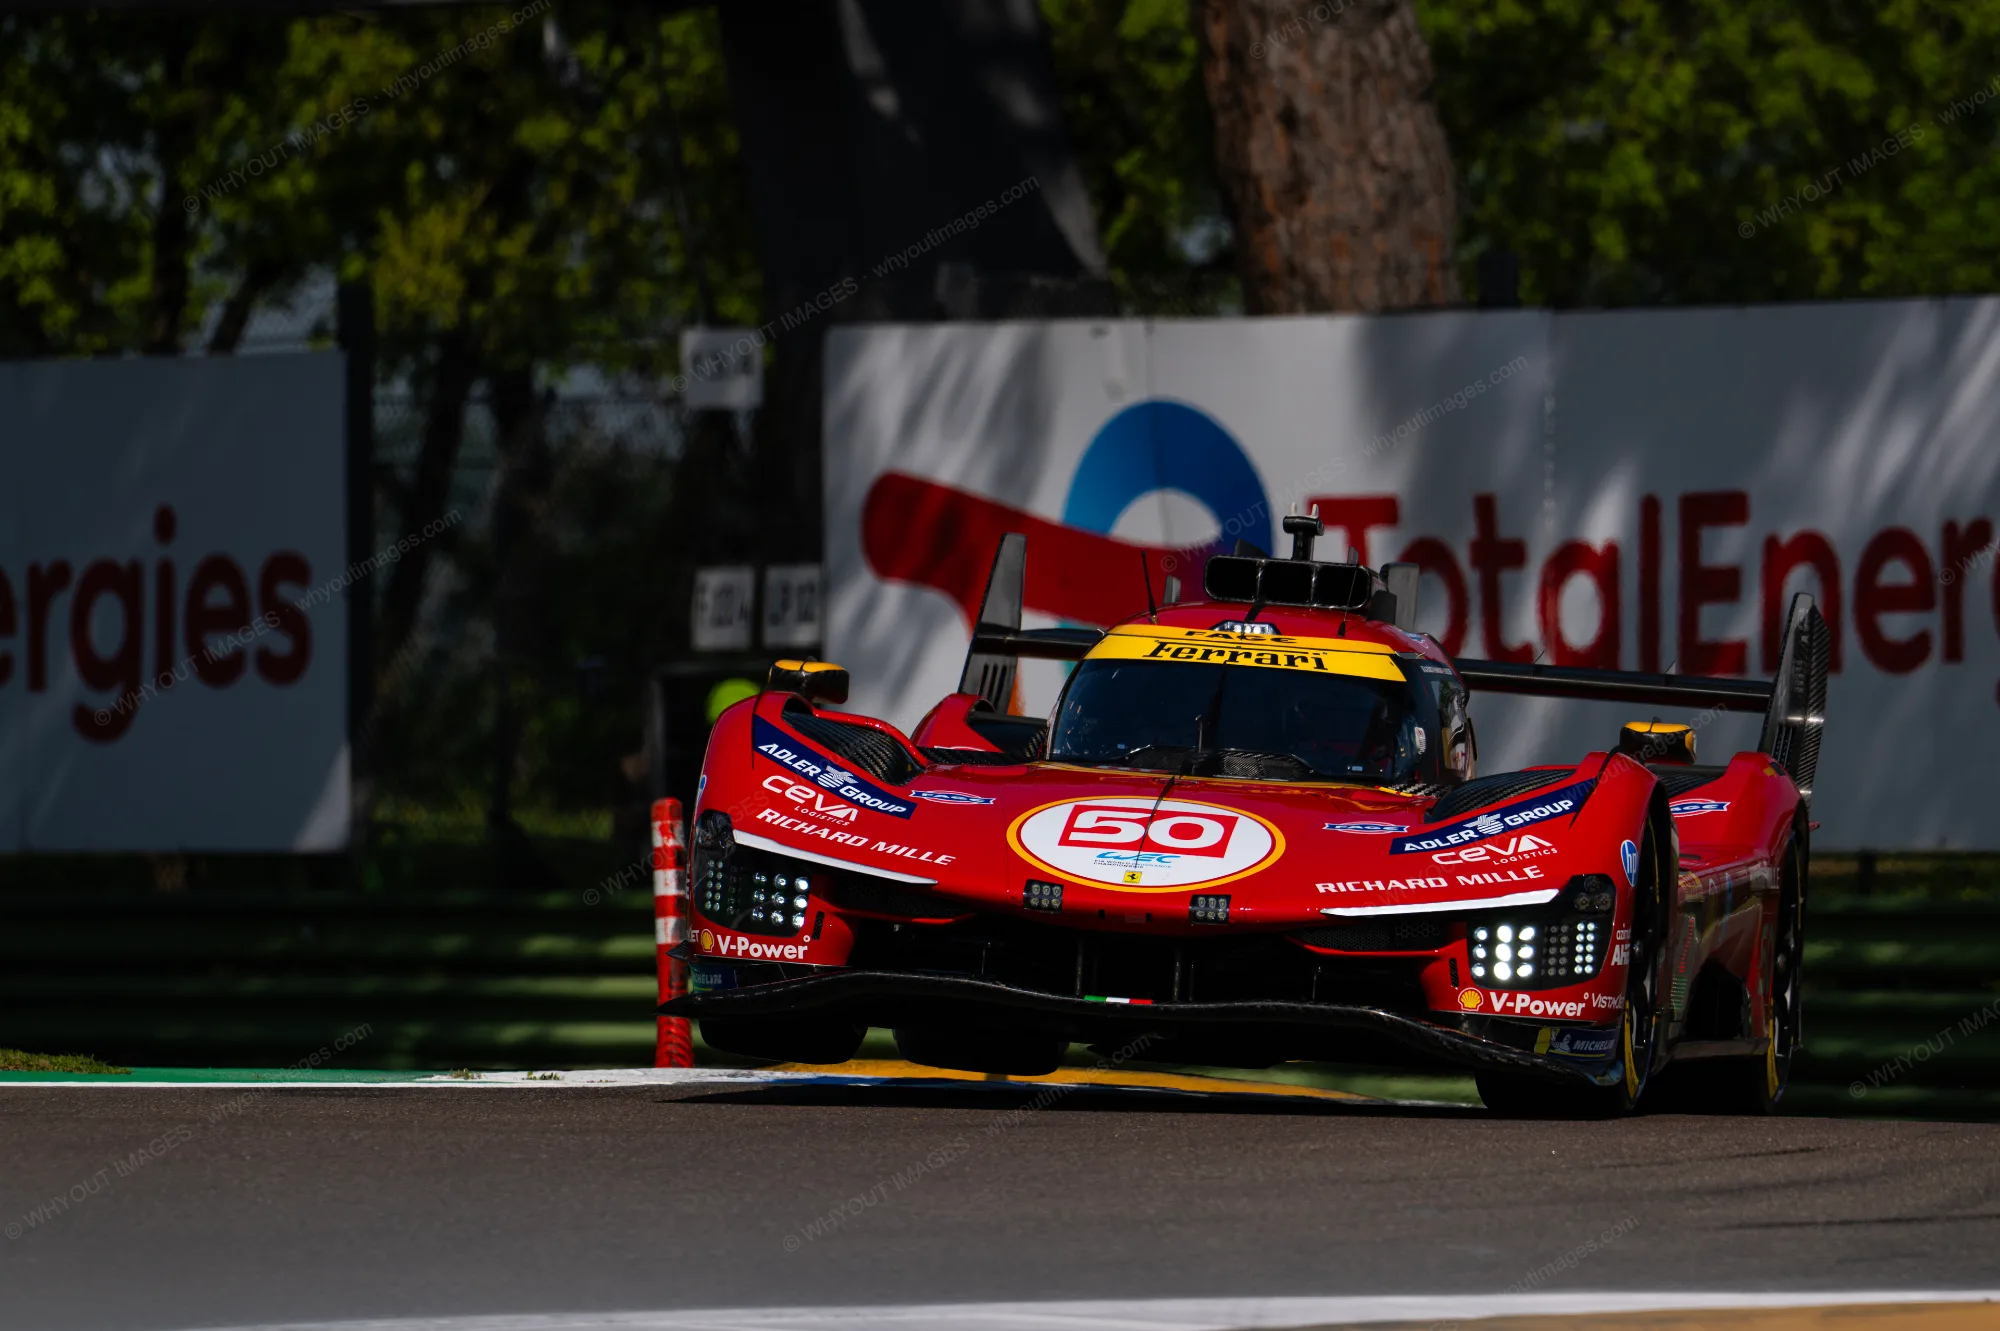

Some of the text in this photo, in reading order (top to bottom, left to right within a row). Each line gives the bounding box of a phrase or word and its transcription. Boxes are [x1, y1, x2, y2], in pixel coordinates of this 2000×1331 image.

[1308, 491, 2000, 680] TotalEner
[1142, 639, 1328, 670] Ferrari
[757, 742, 908, 814] ADLER GROUP
[793, 805, 850, 826] LOGISTICS
[1068, 809, 1225, 849] 50
[1403, 799, 1574, 851] ADLER GROUP
[755, 807, 957, 866] RICHARD MILLE
[1493, 847, 1558, 866] LOGISTICS
[1314, 865, 1545, 894] RICHARD MILLE
[716, 934, 809, 960] V-Power
[1489, 990, 1586, 1017] V-Power
[1573, 1039, 1615, 1051] MICHELIN
